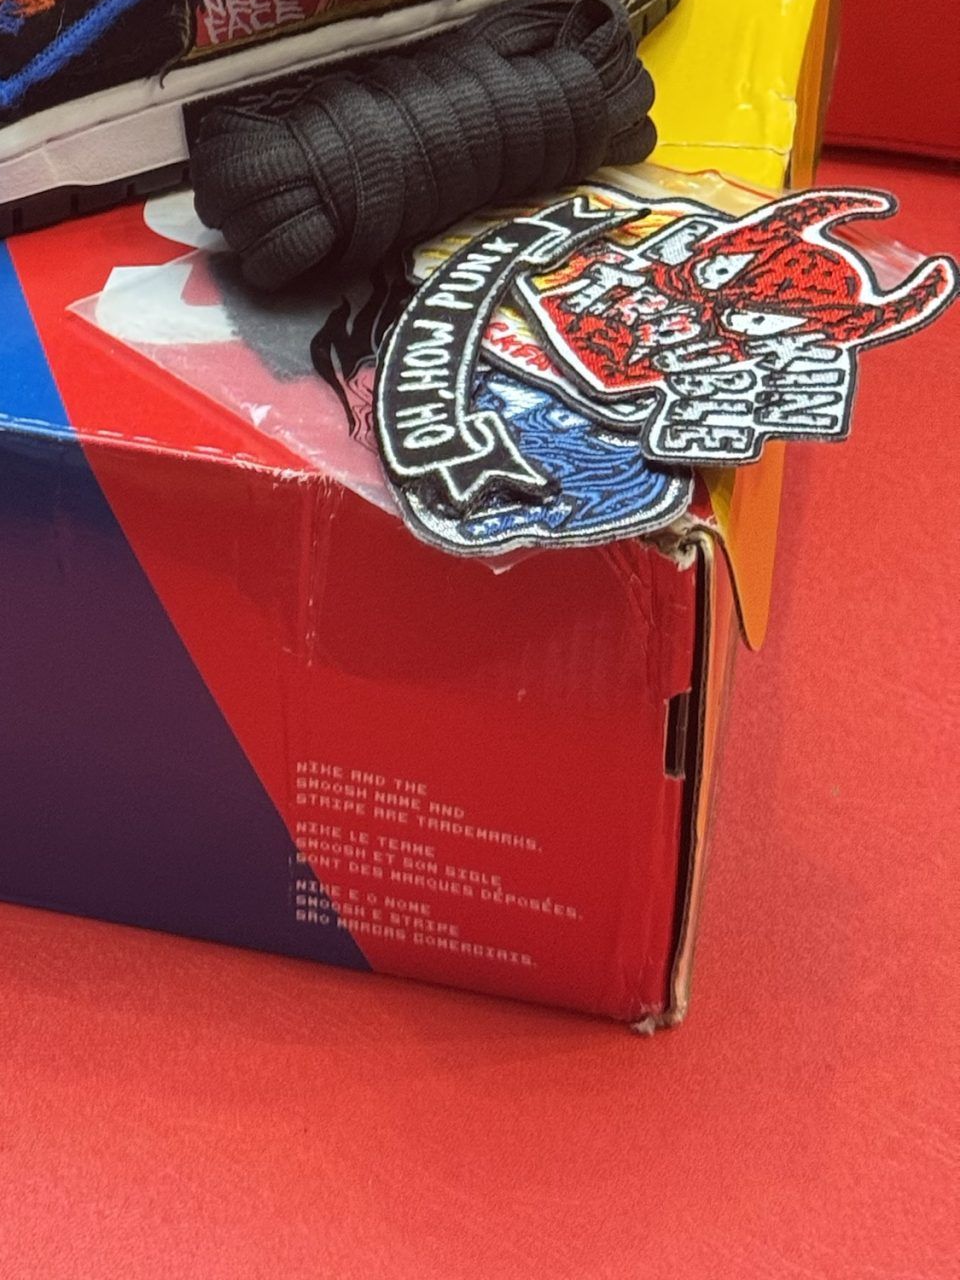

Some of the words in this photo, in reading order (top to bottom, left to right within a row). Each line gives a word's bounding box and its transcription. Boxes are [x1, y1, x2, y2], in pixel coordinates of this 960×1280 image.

[425, 236, 519, 310] PUNK
[296, 761, 343, 779] NIKE
[351, 769, 385, 786] AND
[394, 778, 427, 795] THE
[296, 777, 368, 799] SWOOSH
[374, 791, 421, 810] NAME
[429, 801, 465, 819] AND
[296, 793, 366, 815] STRIPE
[373, 806, 408, 823] ARE
[416, 815, 542, 853] TRADEMARKS.
[296, 821, 341, 838] NIKE
[349, 830, 369, 844] LE
[377, 835, 436, 858] TERME
[296, 837, 366, 859] SWOOSH
[373, 851, 396, 866] ET
[403, 857, 438, 874] SON
[445, 865, 502, 887] SIGLE
[296, 852, 341, 869] SONT
[348, 861, 383, 879] DES
[390, 870, 474, 897] MARQUES
[296, 879, 340, 897] NIKE
[349, 888, 360, 901] E
[384, 895, 431, 917] NOME
[296, 894, 366, 917] SWOOSH
[372, 908, 383, 921] E
[390, 912, 460, 937] STRIPE
[336, 916, 407, 941] MARCAS
